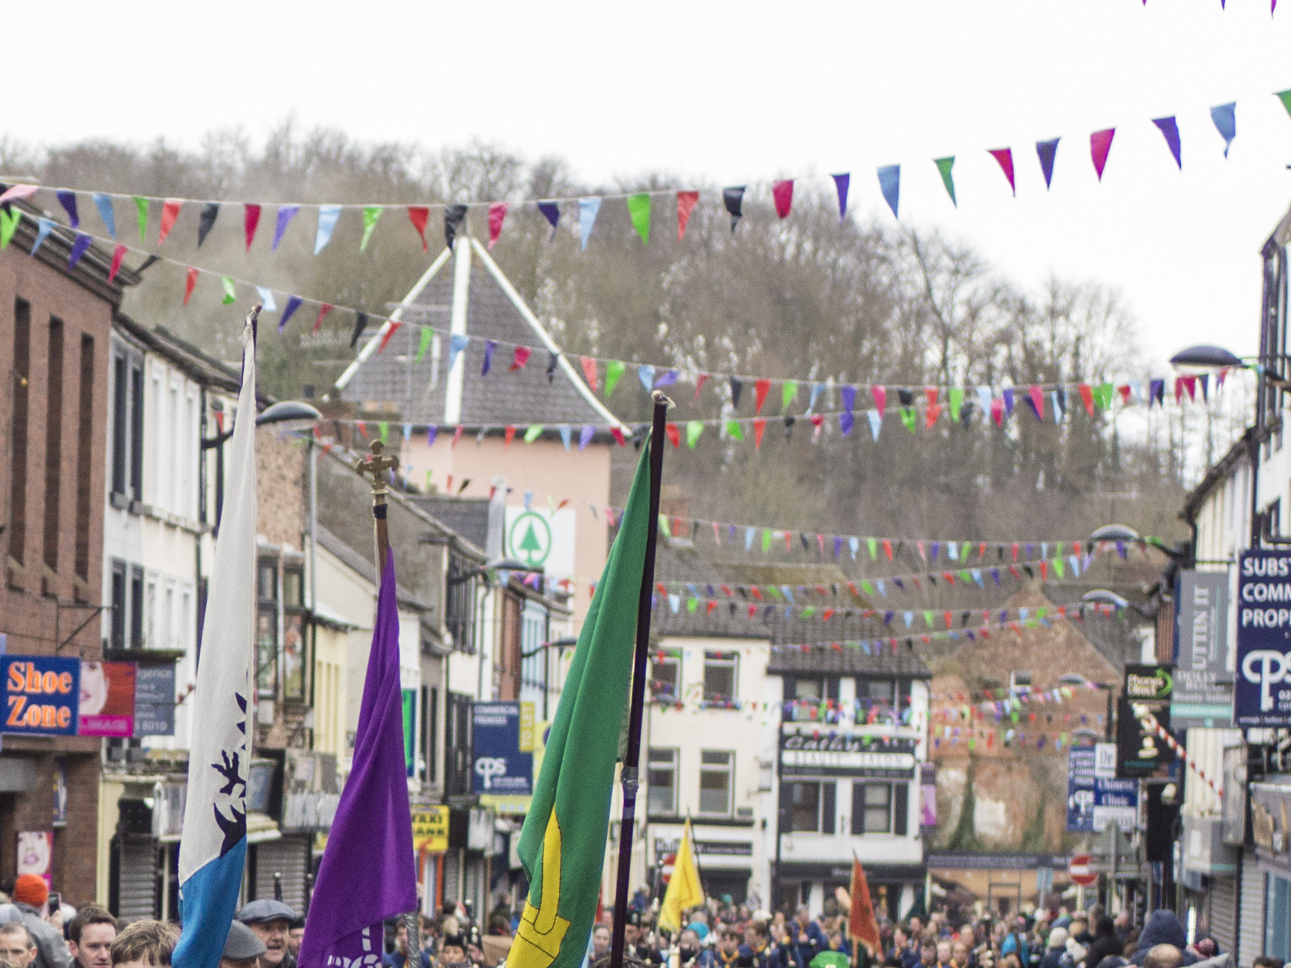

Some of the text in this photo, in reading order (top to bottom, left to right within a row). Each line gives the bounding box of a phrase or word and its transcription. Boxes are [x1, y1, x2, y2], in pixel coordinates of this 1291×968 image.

[1242, 608, 1291, 628] PROP
[1191, 610, 1208, 670] UTTIN
[7, 661, 73, 693] Shoe
[6, 696, 72, 728] Zone
[860, 754, 902, 765] SALON
[416, 827, 445, 836] ANK
